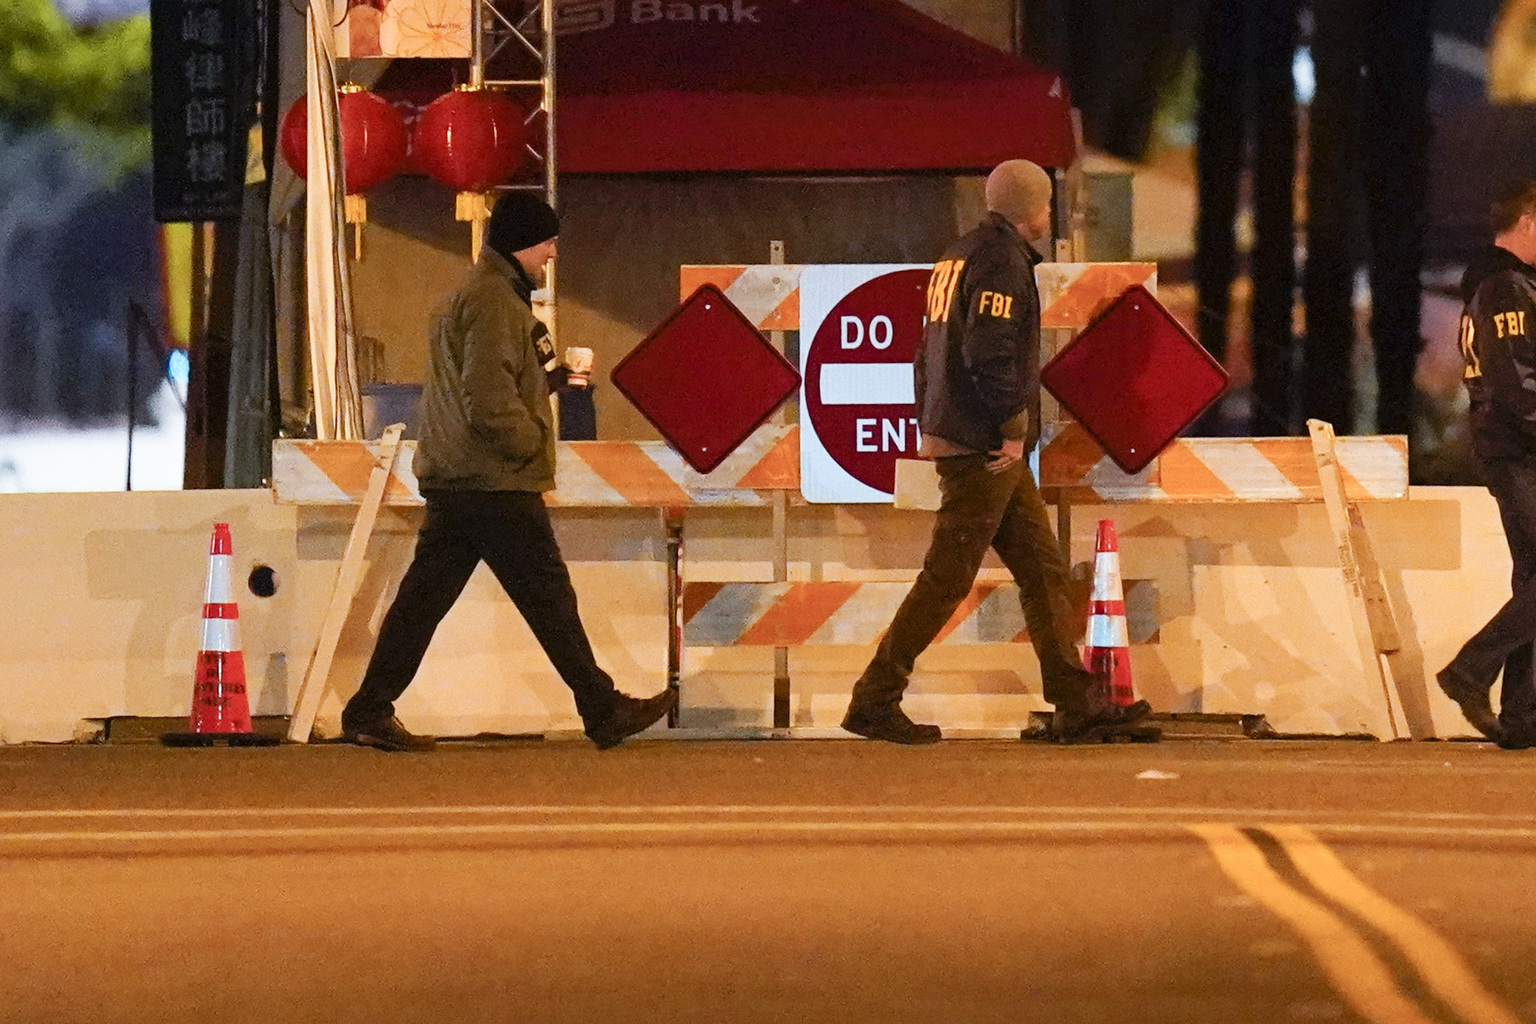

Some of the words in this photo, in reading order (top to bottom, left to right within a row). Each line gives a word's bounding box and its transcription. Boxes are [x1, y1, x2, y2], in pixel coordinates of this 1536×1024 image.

[978, 290, 1014, 320] FBI
[840, 314, 894, 351] DO
[1493, 310, 1526, 339] FBI
